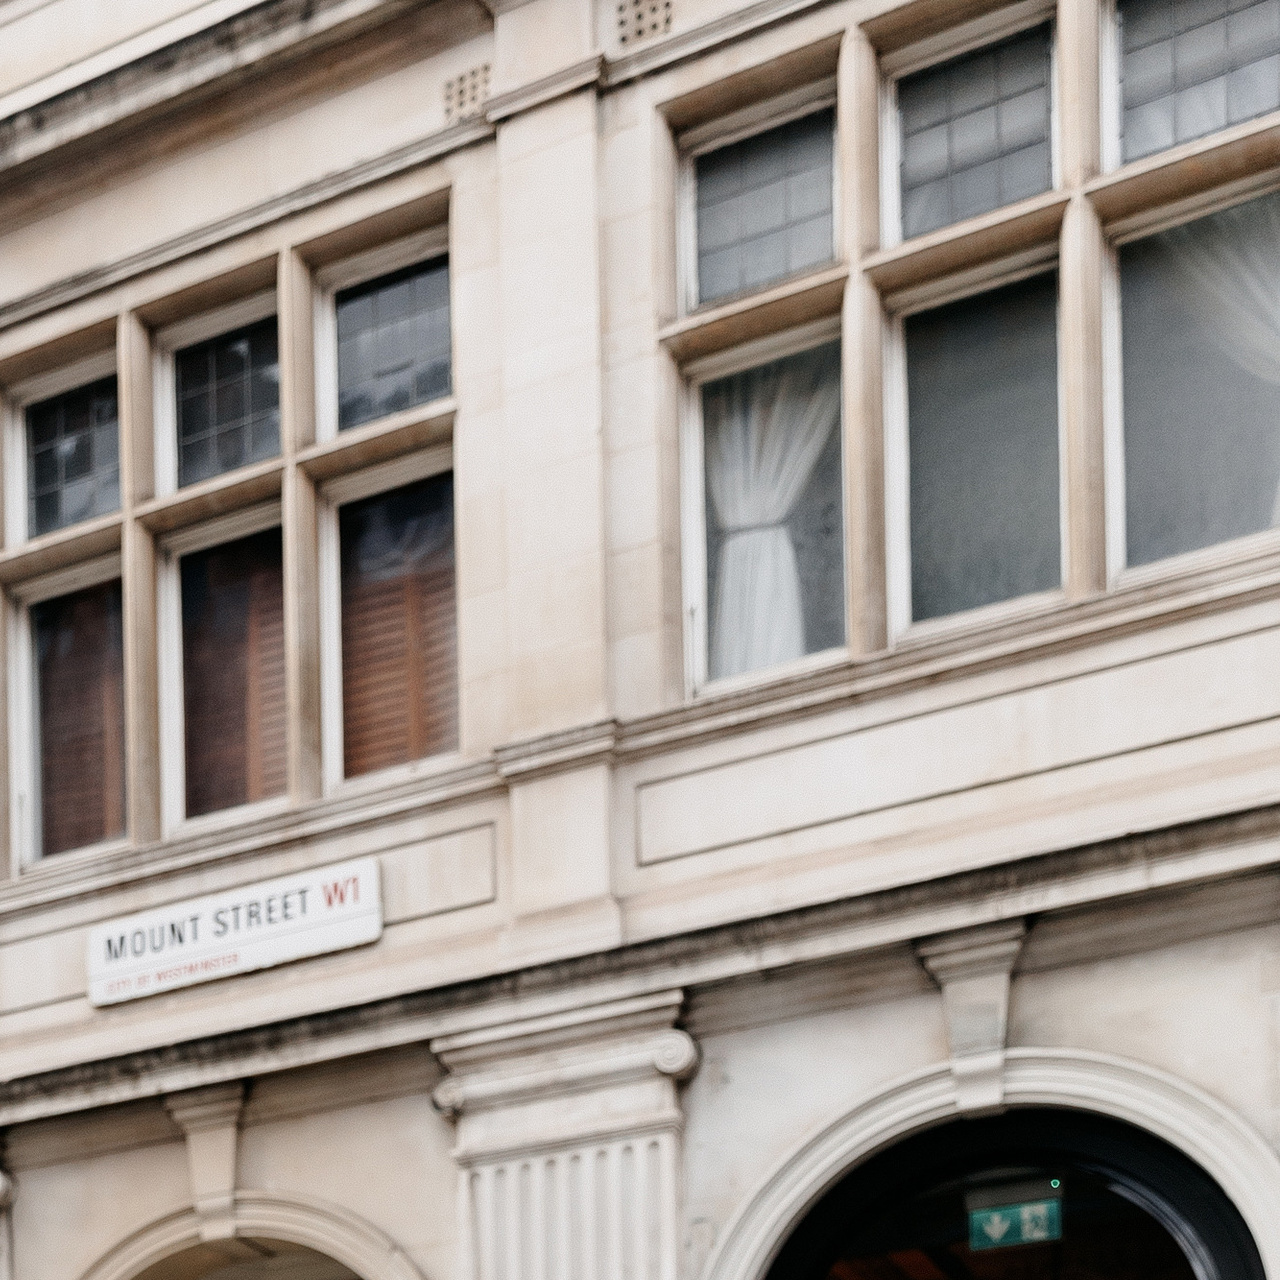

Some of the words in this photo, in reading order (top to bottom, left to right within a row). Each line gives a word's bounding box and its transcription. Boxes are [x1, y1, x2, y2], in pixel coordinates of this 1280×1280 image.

[105, 914, 201, 962] MOUNT
[213, 887, 310, 938] STREET
[322, 876, 360, 908] W1
